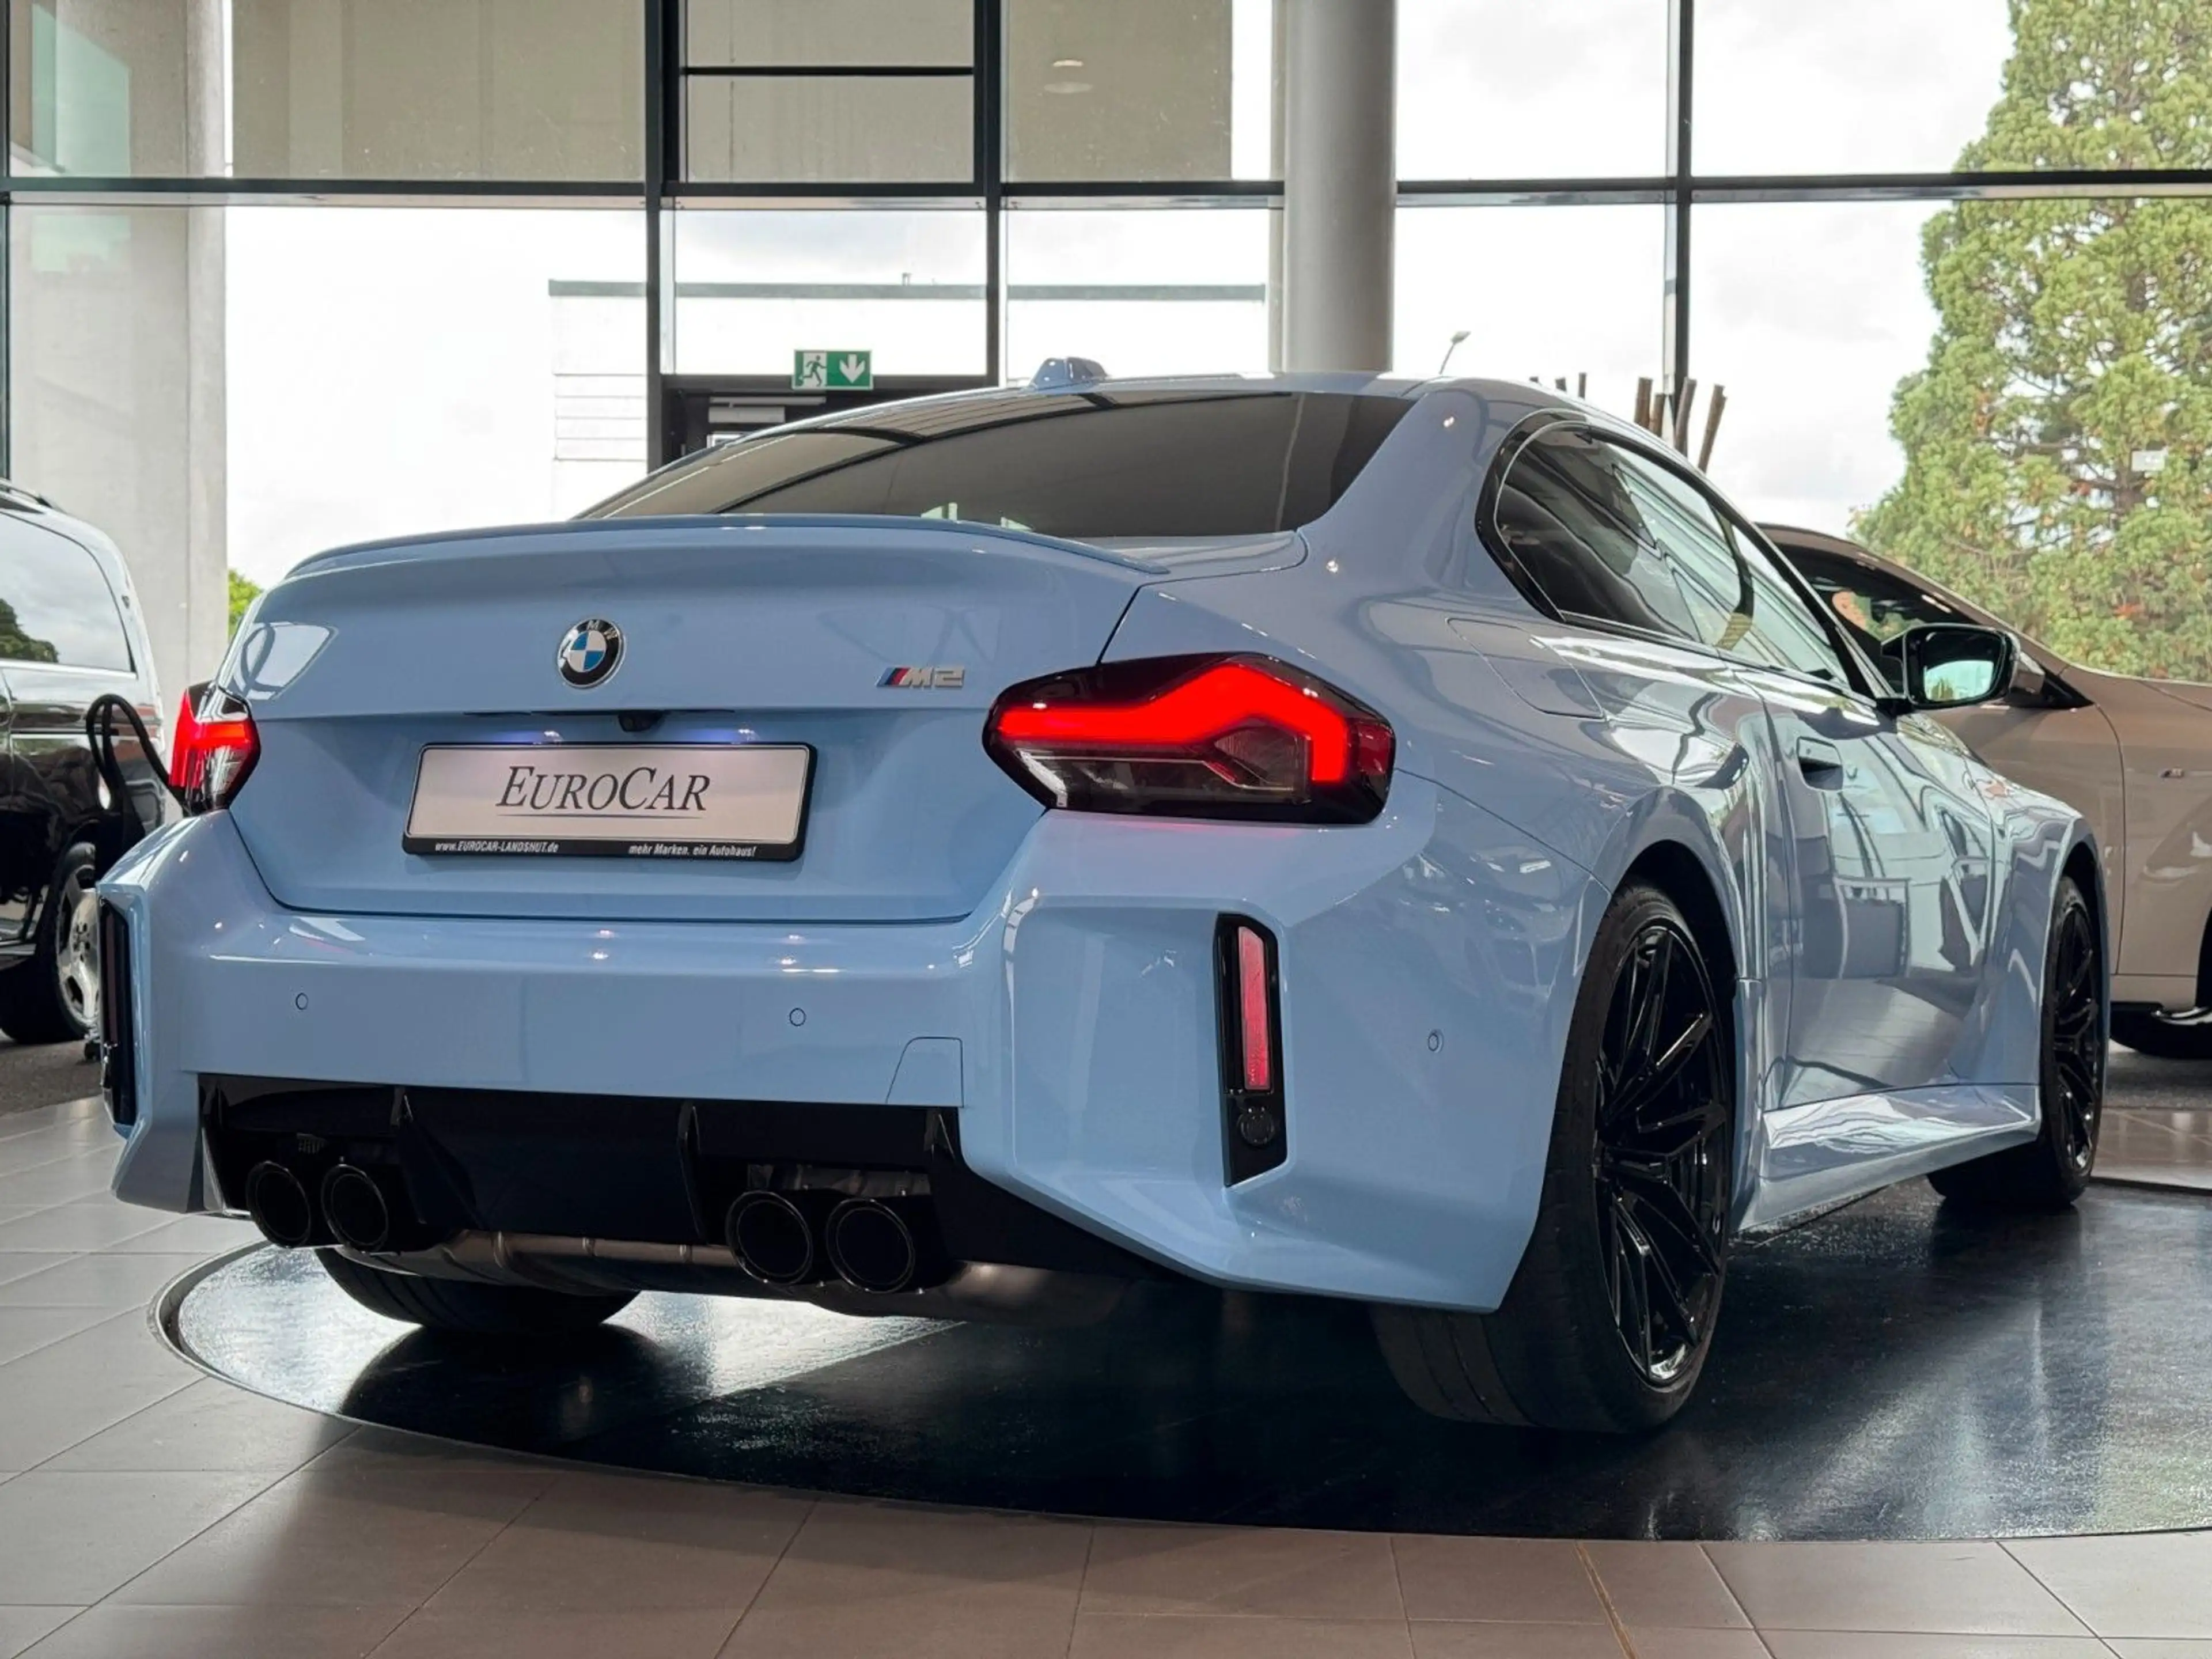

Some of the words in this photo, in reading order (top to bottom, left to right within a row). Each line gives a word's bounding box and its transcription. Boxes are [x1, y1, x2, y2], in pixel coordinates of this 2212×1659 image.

[896, 666, 965, 688] M2
[435, 840, 559, 853] www.EUROCAR-LANDSHUT.de
[629, 843, 653, 855] mehr
[692, 844, 708, 855] ein
[709, 845, 756, 857] Autohaus!
